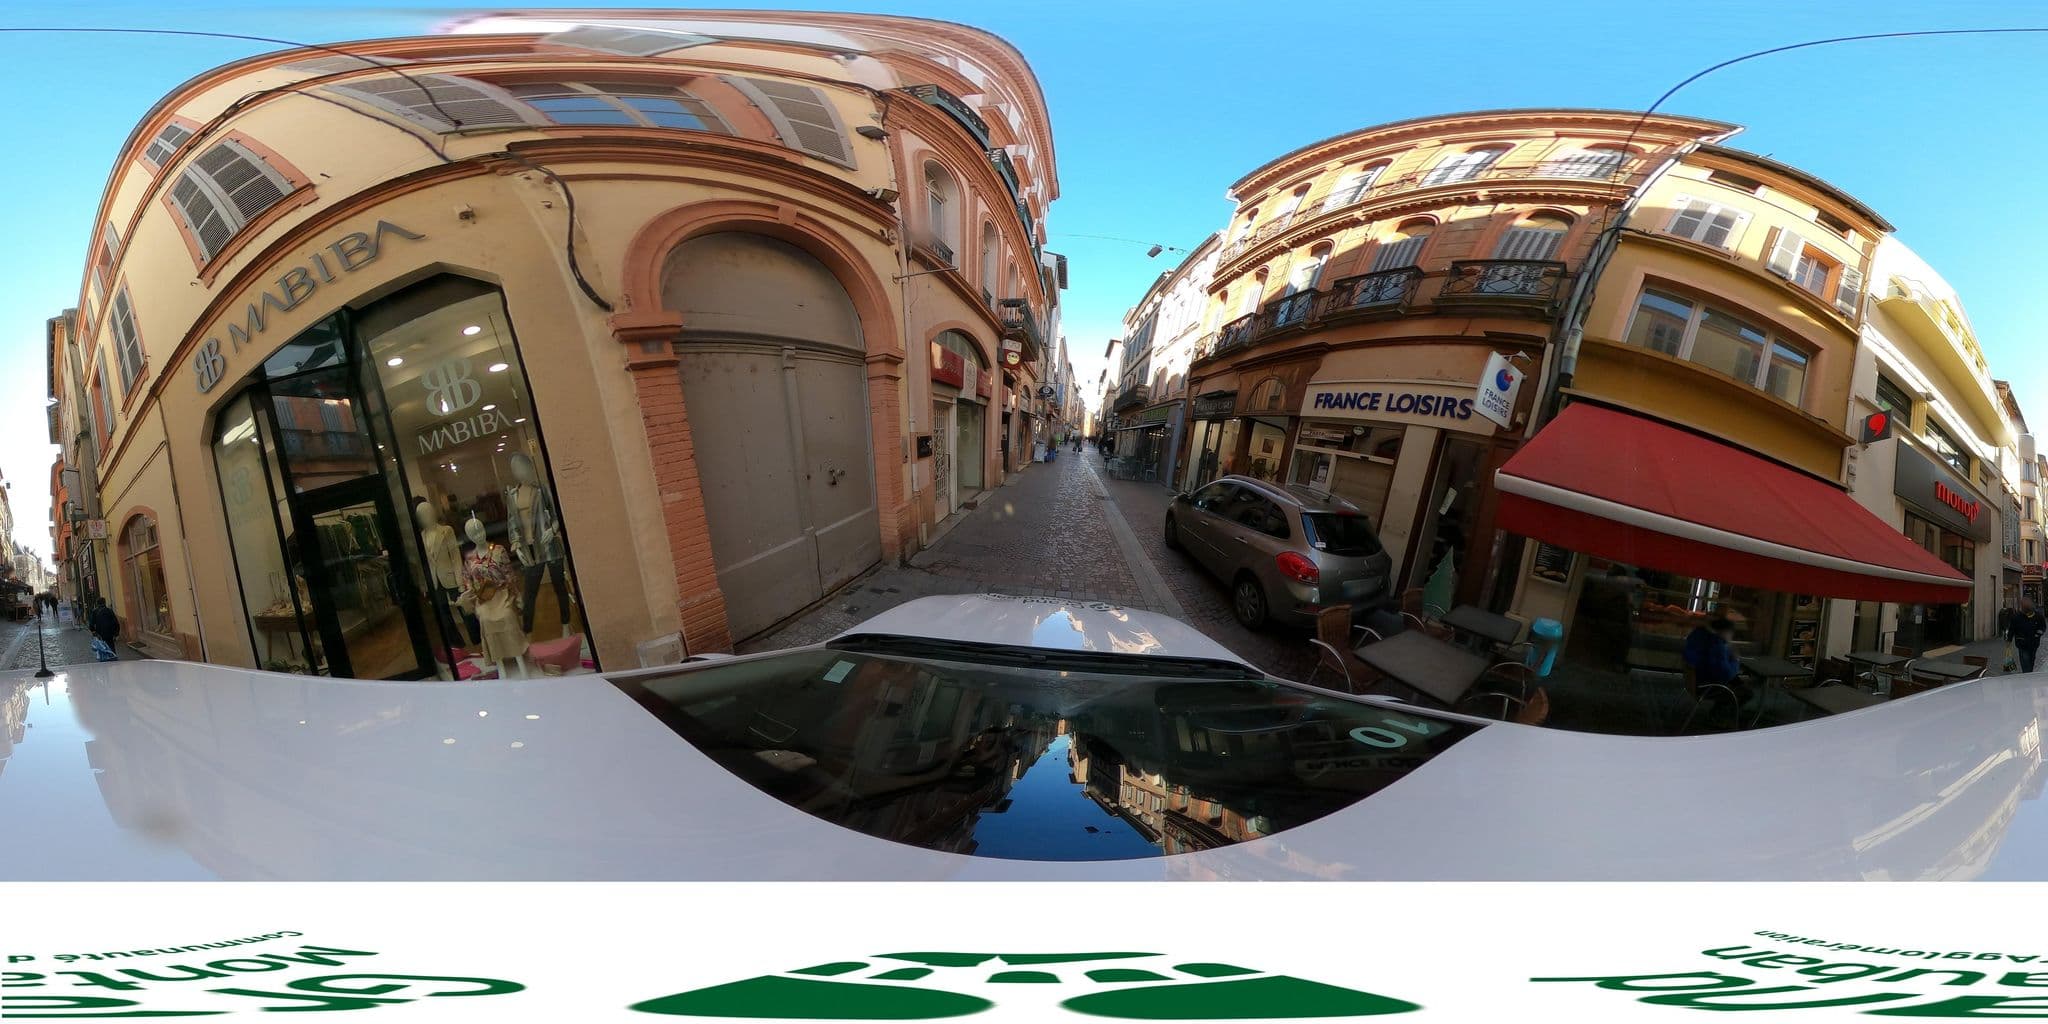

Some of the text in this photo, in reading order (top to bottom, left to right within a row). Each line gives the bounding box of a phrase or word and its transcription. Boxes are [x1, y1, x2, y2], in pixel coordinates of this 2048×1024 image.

[228, 220, 426, 354] MABIBA
[1314, 391, 1474, 420] FRANCE LOISIRS
[1482, 397, 1508, 418] LOISIRS
[1485, 387, 1510, 410] FRANCE
[418, 409, 512, 455] MABIBA
